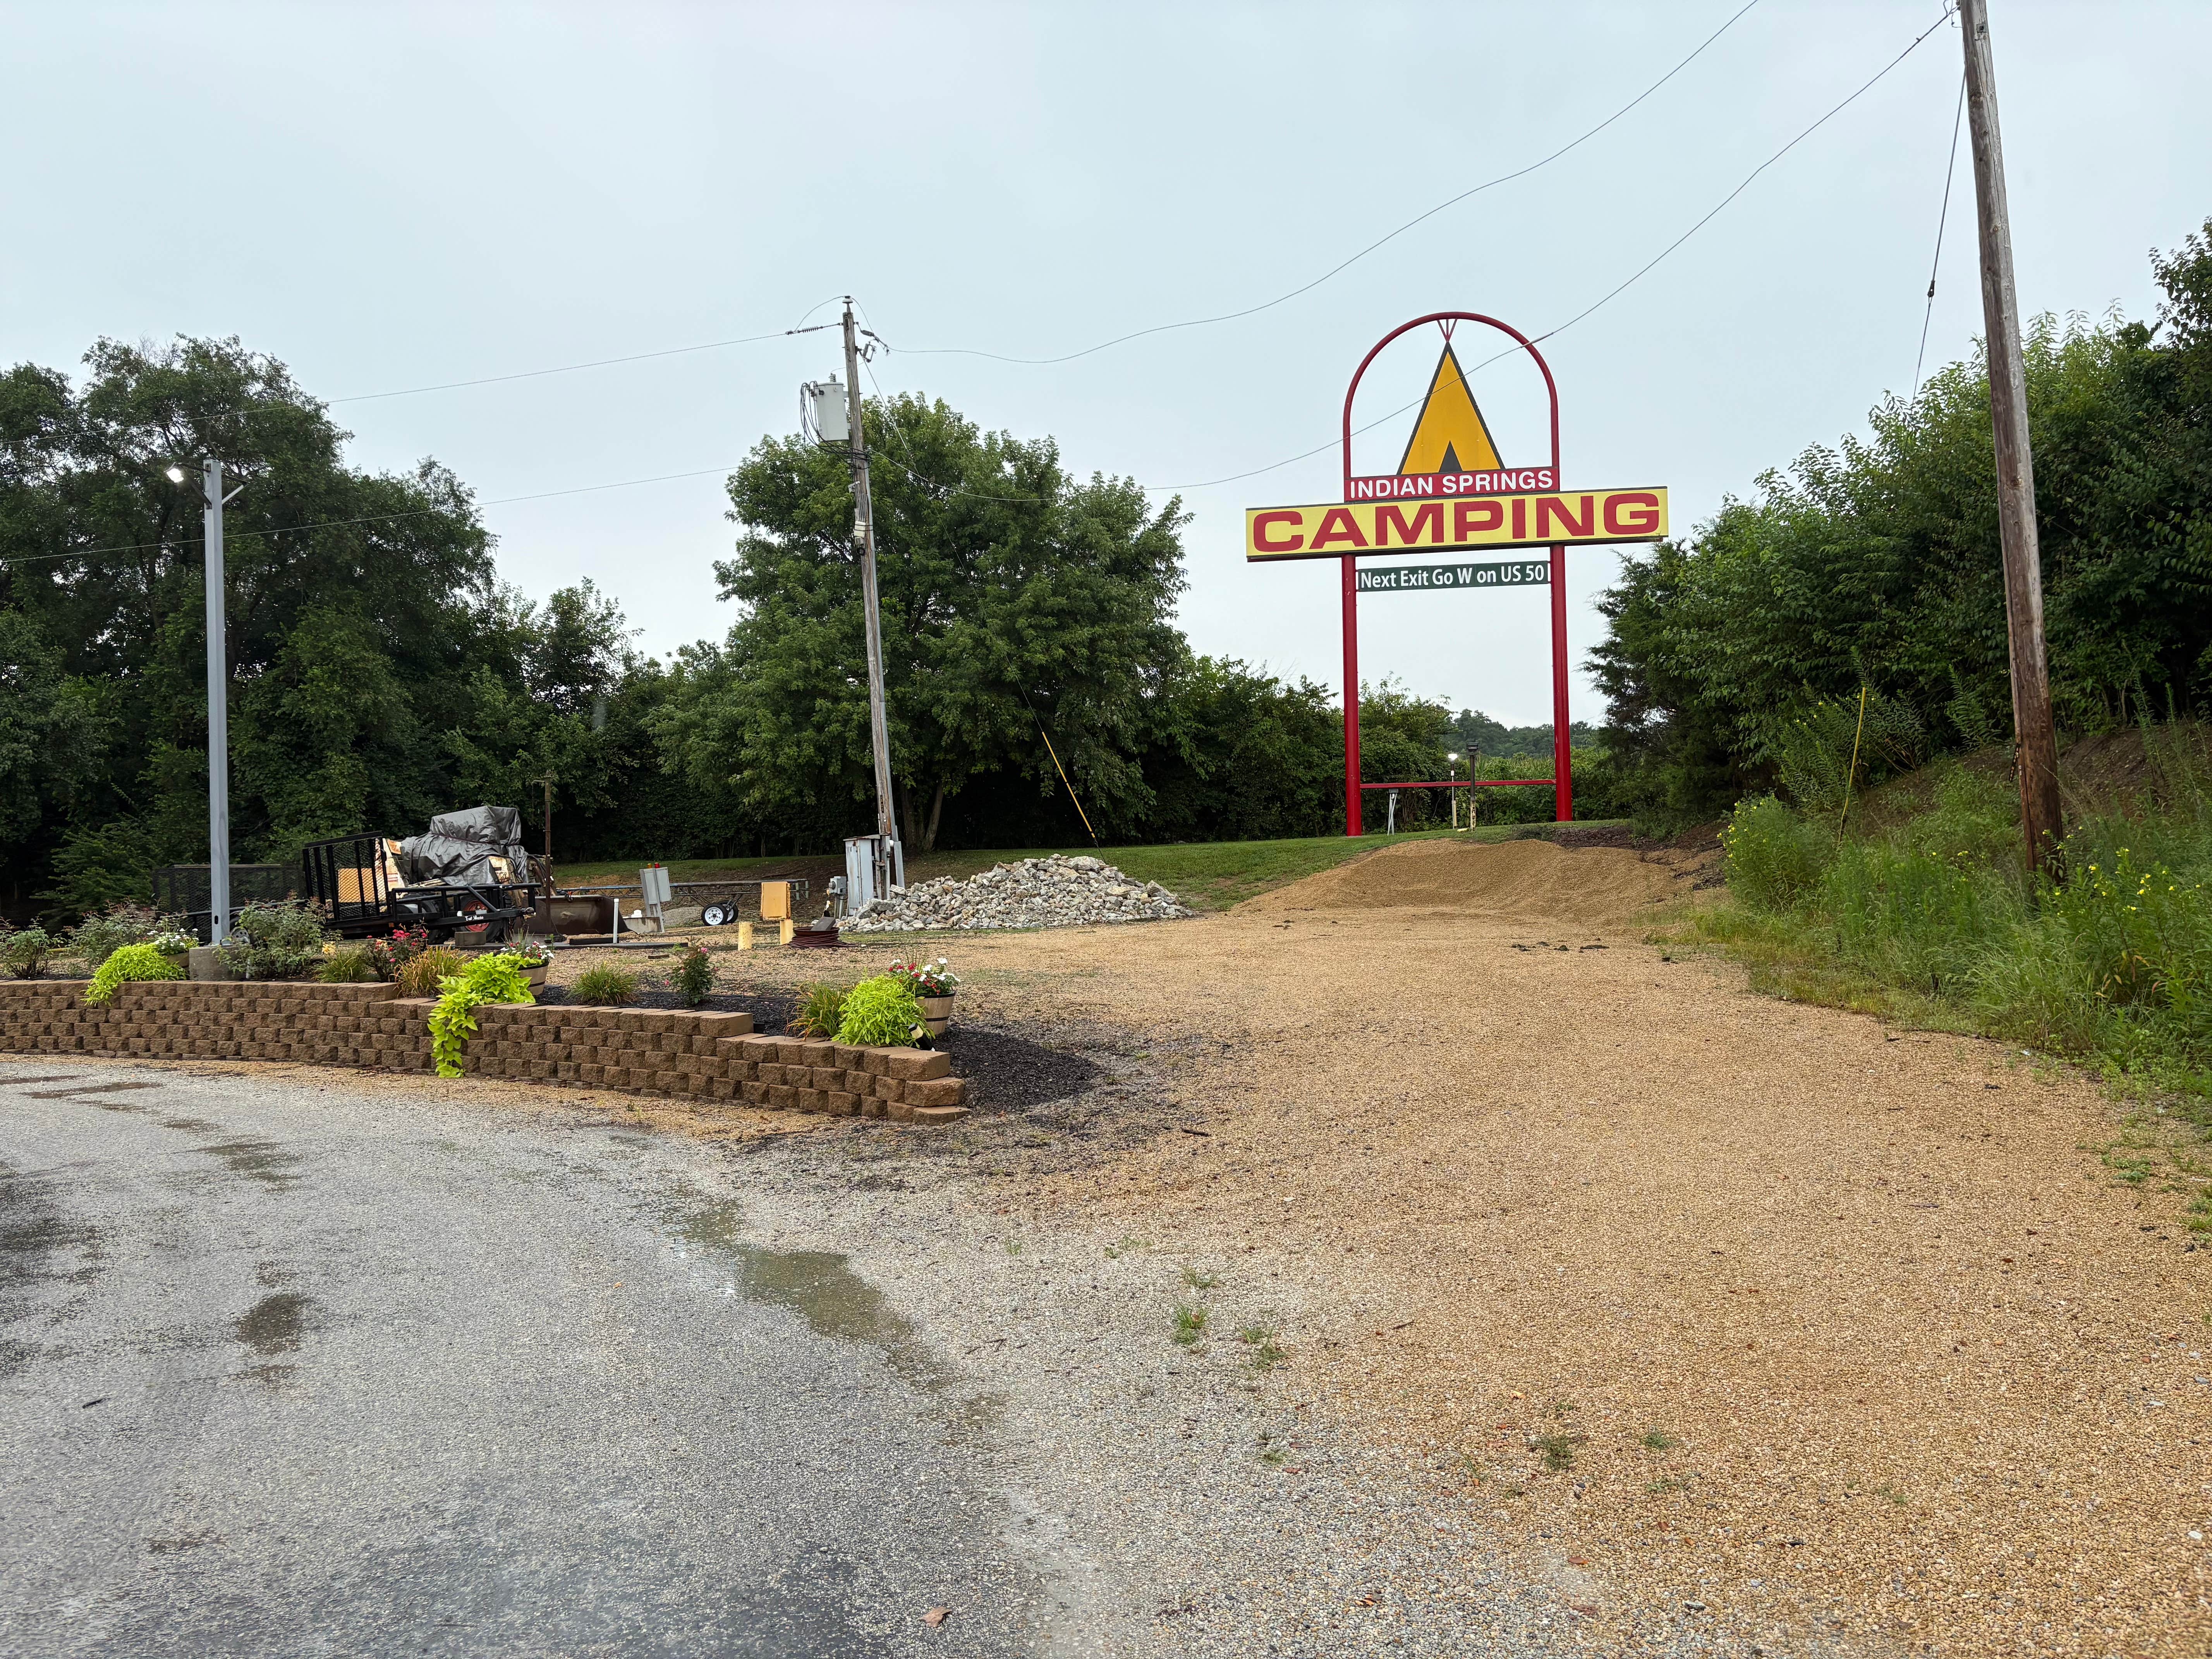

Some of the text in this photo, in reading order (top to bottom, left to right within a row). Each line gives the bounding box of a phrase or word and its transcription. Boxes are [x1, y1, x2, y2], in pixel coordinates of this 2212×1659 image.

[1350, 470, 1553, 499] INDIAN SPRINGS
[1253, 493, 1659, 553] CAMPING
[1361, 564, 1545, 589] Next Exit Go W on US 50
